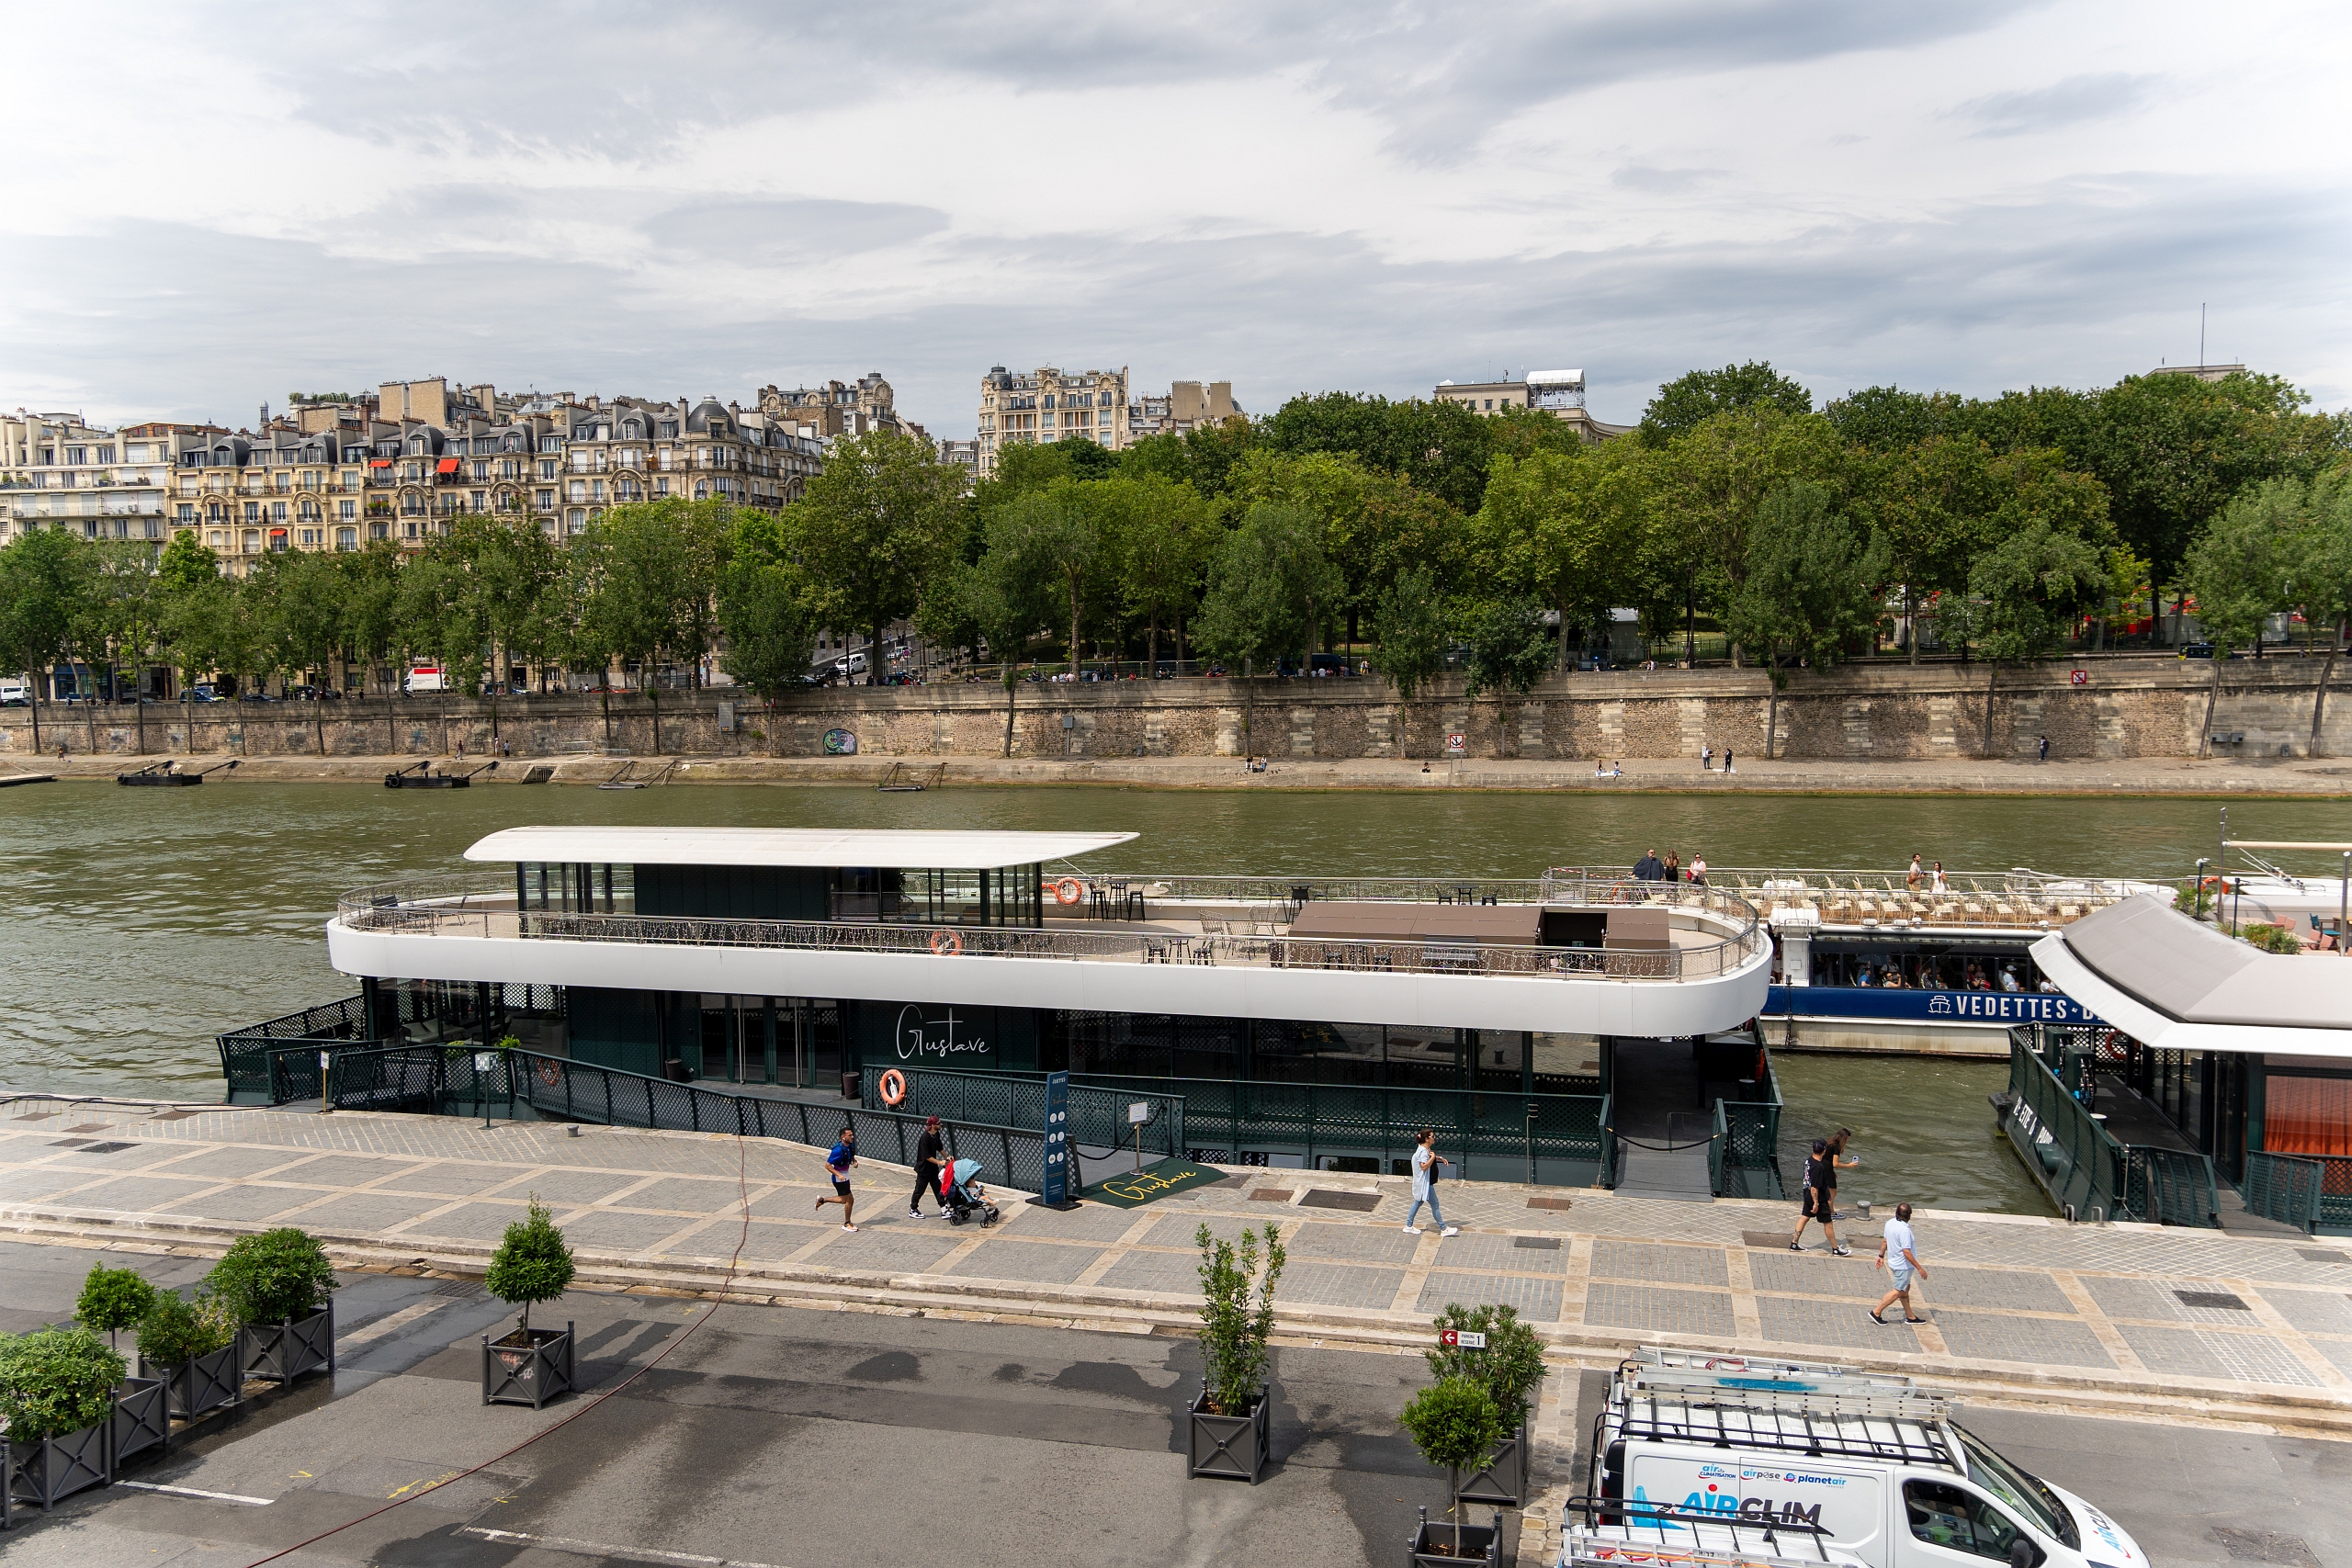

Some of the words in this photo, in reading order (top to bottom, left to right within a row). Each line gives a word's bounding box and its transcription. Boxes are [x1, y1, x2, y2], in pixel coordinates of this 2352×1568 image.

[1956, 996, 2067, 1019] VEDETTES
[896, 1004, 990, 1059] Gustave
[1102, 1171, 1196, 1200] Gustave
[1476, 1335, 1480, 1345] 1
[1699, 1471, 1736, 1479] CLIMATISATION
[1702, 1463, 1719, 1472] air
